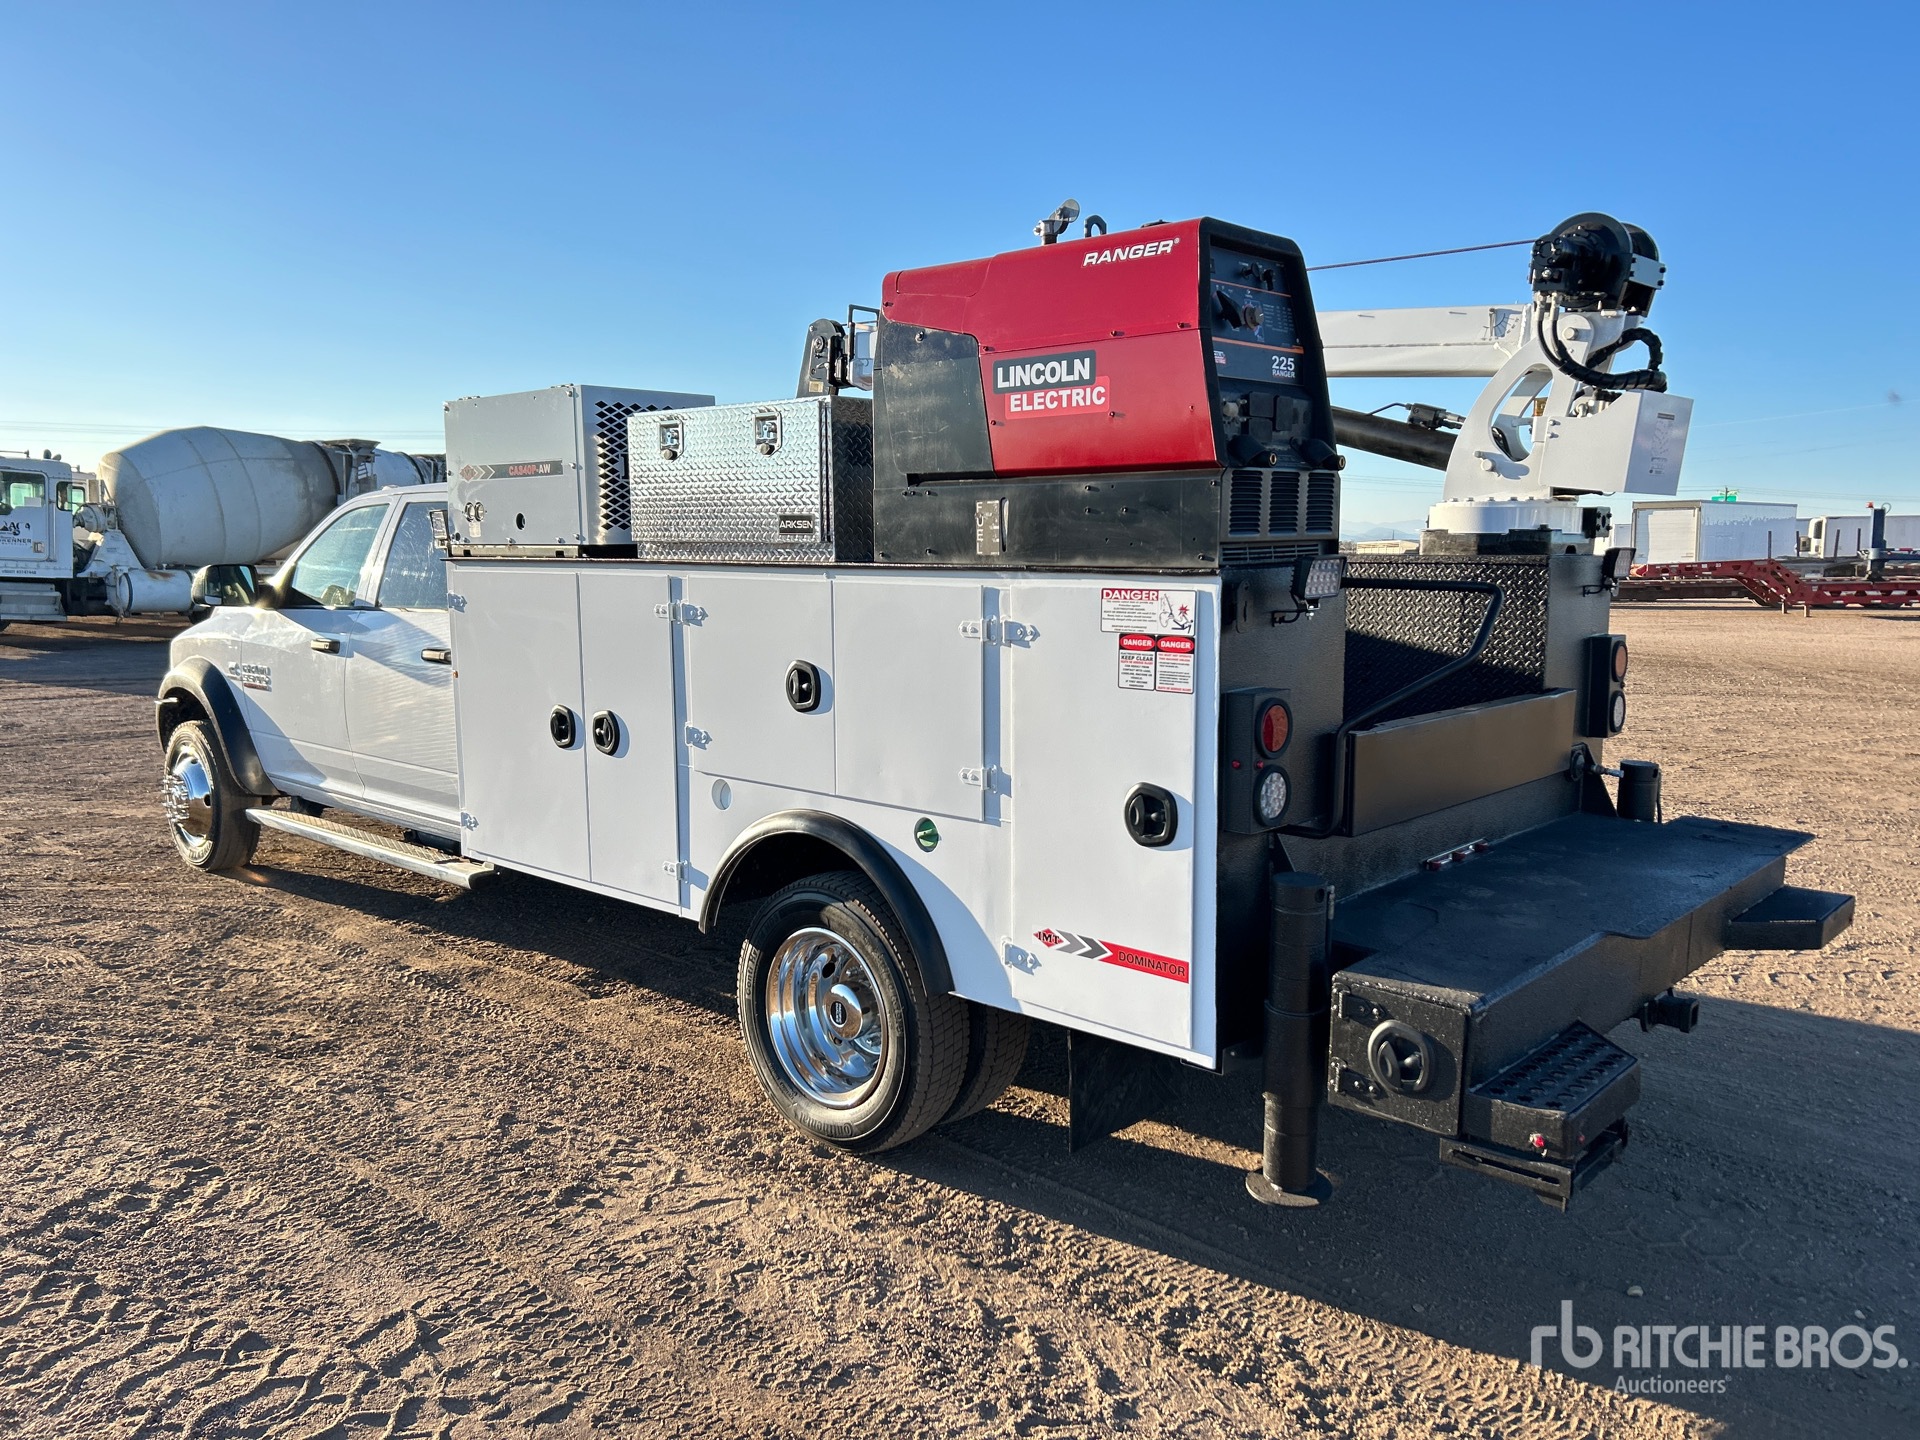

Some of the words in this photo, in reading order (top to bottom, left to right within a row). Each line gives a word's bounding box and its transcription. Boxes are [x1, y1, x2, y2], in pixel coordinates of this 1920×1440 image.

[1271, 355, 1295, 371] 225
[997, 357, 1090, 389] LINCOLN
[1272, 369, 1296, 379] RANGER
[1010, 386, 1106, 413] ELECTRIC
[779, 520, 814, 529] ARKSEN
[1103, 590, 1158, 600] DANGER
[1123, 638, 1152, 647] DANGER
[1160, 641, 1190, 649] DANGER
[1038, 931, 1060, 945] IMT
[1118, 951, 1185, 976] DOMINATOR
